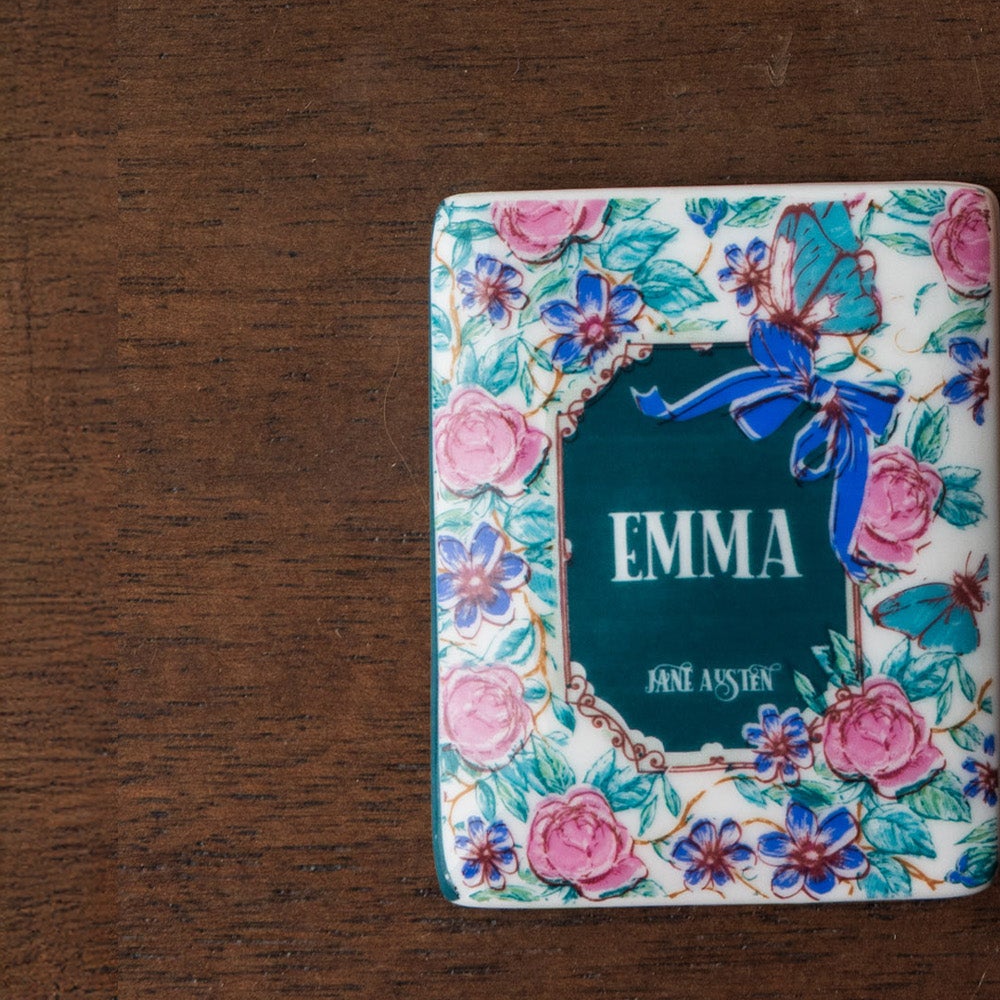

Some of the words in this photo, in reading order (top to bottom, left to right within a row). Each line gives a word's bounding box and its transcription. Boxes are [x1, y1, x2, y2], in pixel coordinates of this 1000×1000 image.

[608, 508, 803, 582] EMMA
[645, 661, 694, 694] JANE
[699, 662, 782, 702] AUSTEN
